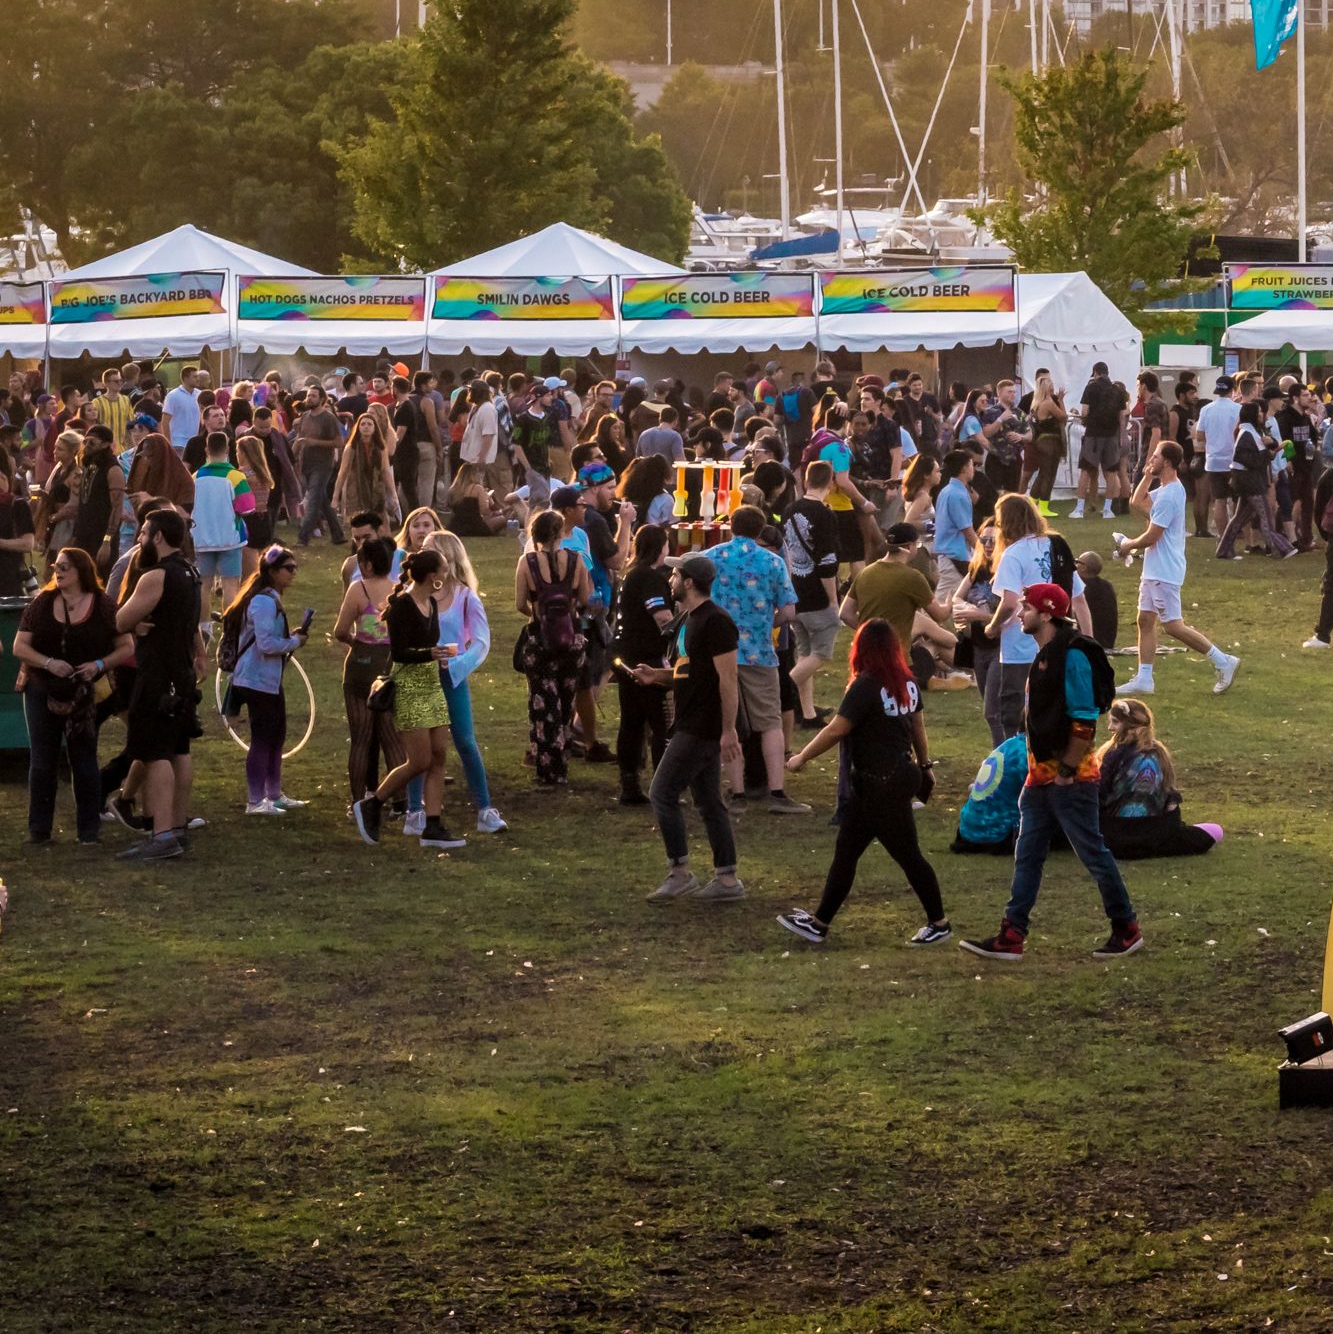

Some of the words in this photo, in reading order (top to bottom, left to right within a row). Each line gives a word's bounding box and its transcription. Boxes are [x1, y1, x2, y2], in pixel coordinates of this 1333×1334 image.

[1251, 277, 1284, 286] FRUIT
[1287, 277, 1328, 286] JUICES
[664, 292, 687, 304] ICE
[691, 291, 729, 304] COLD
[733, 291, 770, 303] BEER
[863, 288, 885, 299] ICE
[888, 286, 929, 299] COLD
[933, 285, 970, 297] BEER
[84, 293, 116, 308] JOE'S
[120, 290, 186, 305] BACKYARD
[250, 295, 272, 305] HOT
[275, 295, 307, 305] DOGS
[310, 295, 356, 305] NACHOS
[359, 295, 414, 305] PRETZELS
[477, 294, 519, 305] SMILIN
[522, 294, 570, 305] DAWGS
